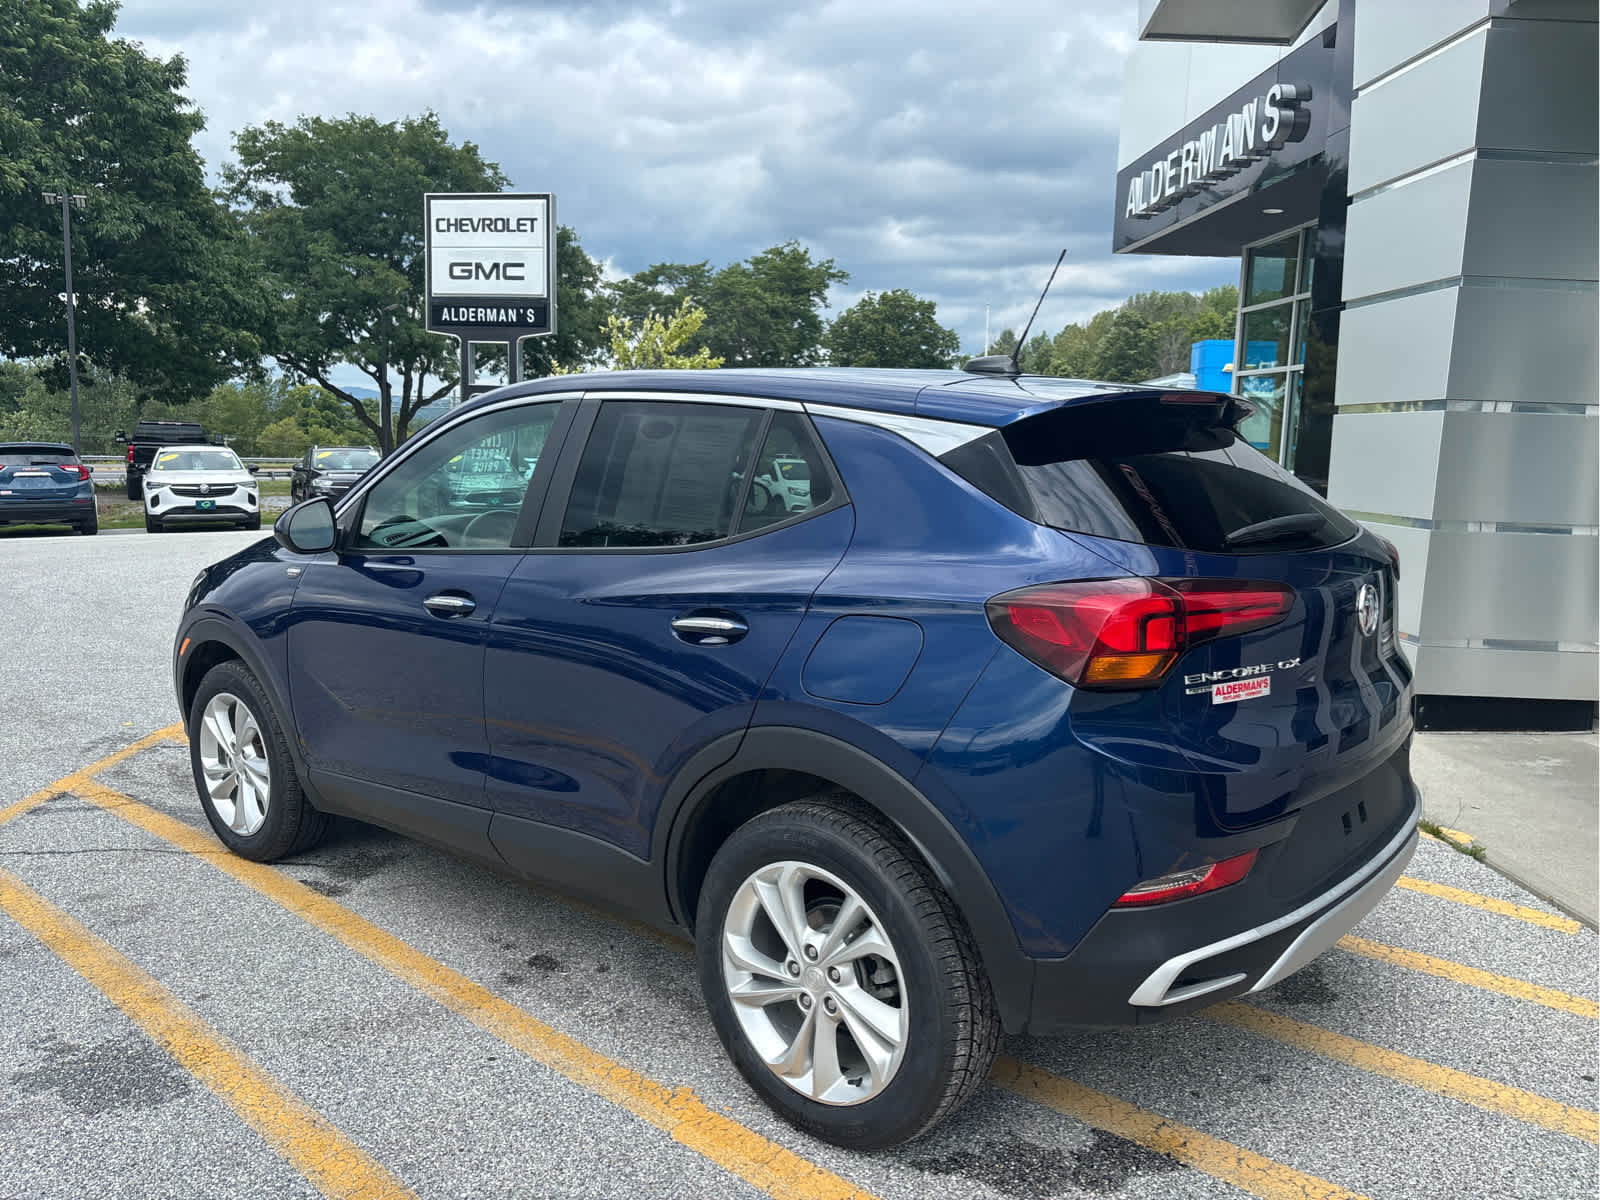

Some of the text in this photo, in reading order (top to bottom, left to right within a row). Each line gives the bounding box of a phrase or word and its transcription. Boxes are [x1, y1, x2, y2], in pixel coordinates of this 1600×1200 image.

[435, 217, 538, 233] CHEVROLET
[448, 261, 525, 281] GMC
[441, 307, 535, 323] ALDERMAN'S
[1184, 657, 1301, 685] ENCORE GX
[1215, 678, 1269, 697] ALDERMAN'S
